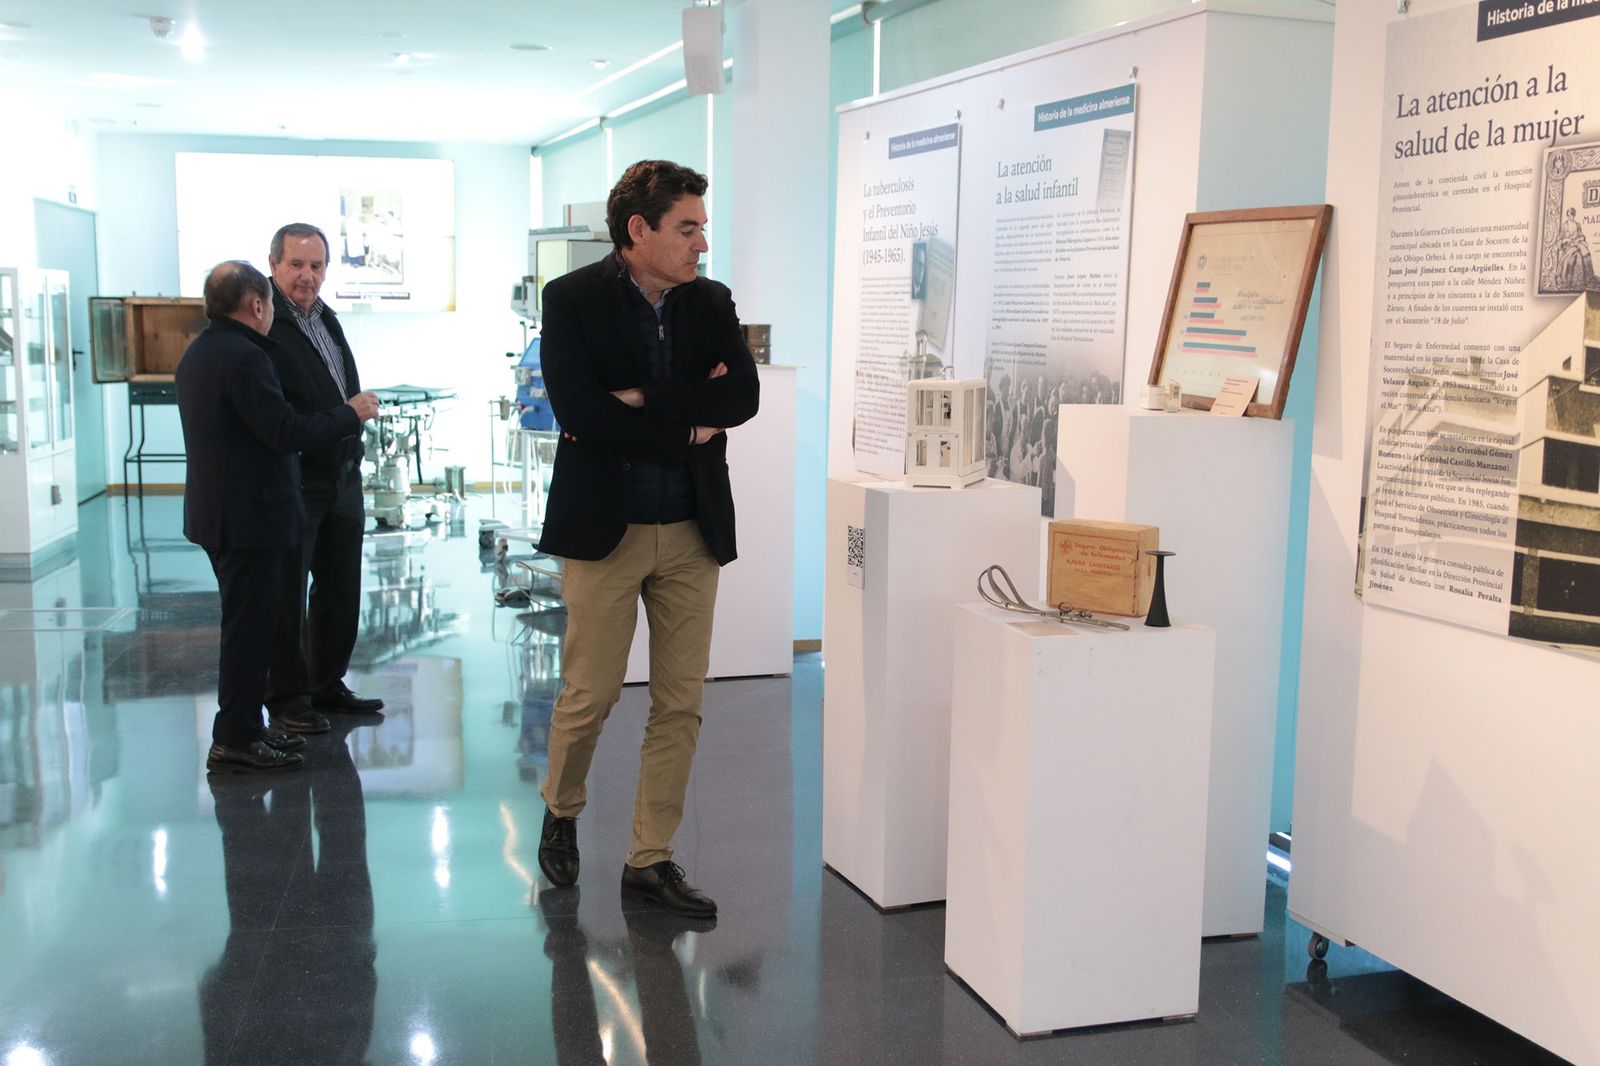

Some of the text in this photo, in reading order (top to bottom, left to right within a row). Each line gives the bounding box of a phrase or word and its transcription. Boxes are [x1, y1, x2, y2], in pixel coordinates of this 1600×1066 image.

[1487, 2, 1534, 26] Historia
[1537, 0, 1554, 14] de
[1396, 64, 1568, 119] La atención a la
[1038, 111, 1058, 122] Historia
[1060, 109, 1066, 118] de
[1074, 102, 1098, 115] medicina
[1099, 96, 1130, 110] almeriense
[1394, 110, 1584, 159] salud de la mujer
[998, 154, 1052, 178] La atención
[1439, 174, 1468, 184] contienda
[1474, 172, 1486, 180] civil
[1505, 168, 1533, 177] atención
[864, 176, 915, 197] La tuberculosis
[996, 177, 1079, 205] a la salud infantil
[1452, 182, 1532, 196] centraba Hospital
[868, 204, 875, 219] el
[876, 199, 916, 219] Preventorio
[863, 218, 938, 242] Infantil del Niño Jesús
[1441, 227, 1455, 235] Civil
[1493, 222, 1529, 231] maternidad
[1492, 249, 1527, 258] encontraba
[1388, 268, 1402, 277] Juan
[1404, 267, 1418, 276] José
[1420, 266, 1446, 276] Jiménez
[1432, 278, 1445, 288] pasó
[1393, 341, 1412, 351] Seguro
[1503, 371, 1518, 380] José
[1458, 446, 1488, 455] Cristóbal
[1489, 449, 1512, 458] Gómez
[1480, 527, 1496, 535] todos
[1498, 529, 1507, 537] los
[1447, 561, 1472, 570] consulta
[1478, 591, 1502, 602] Peralta
